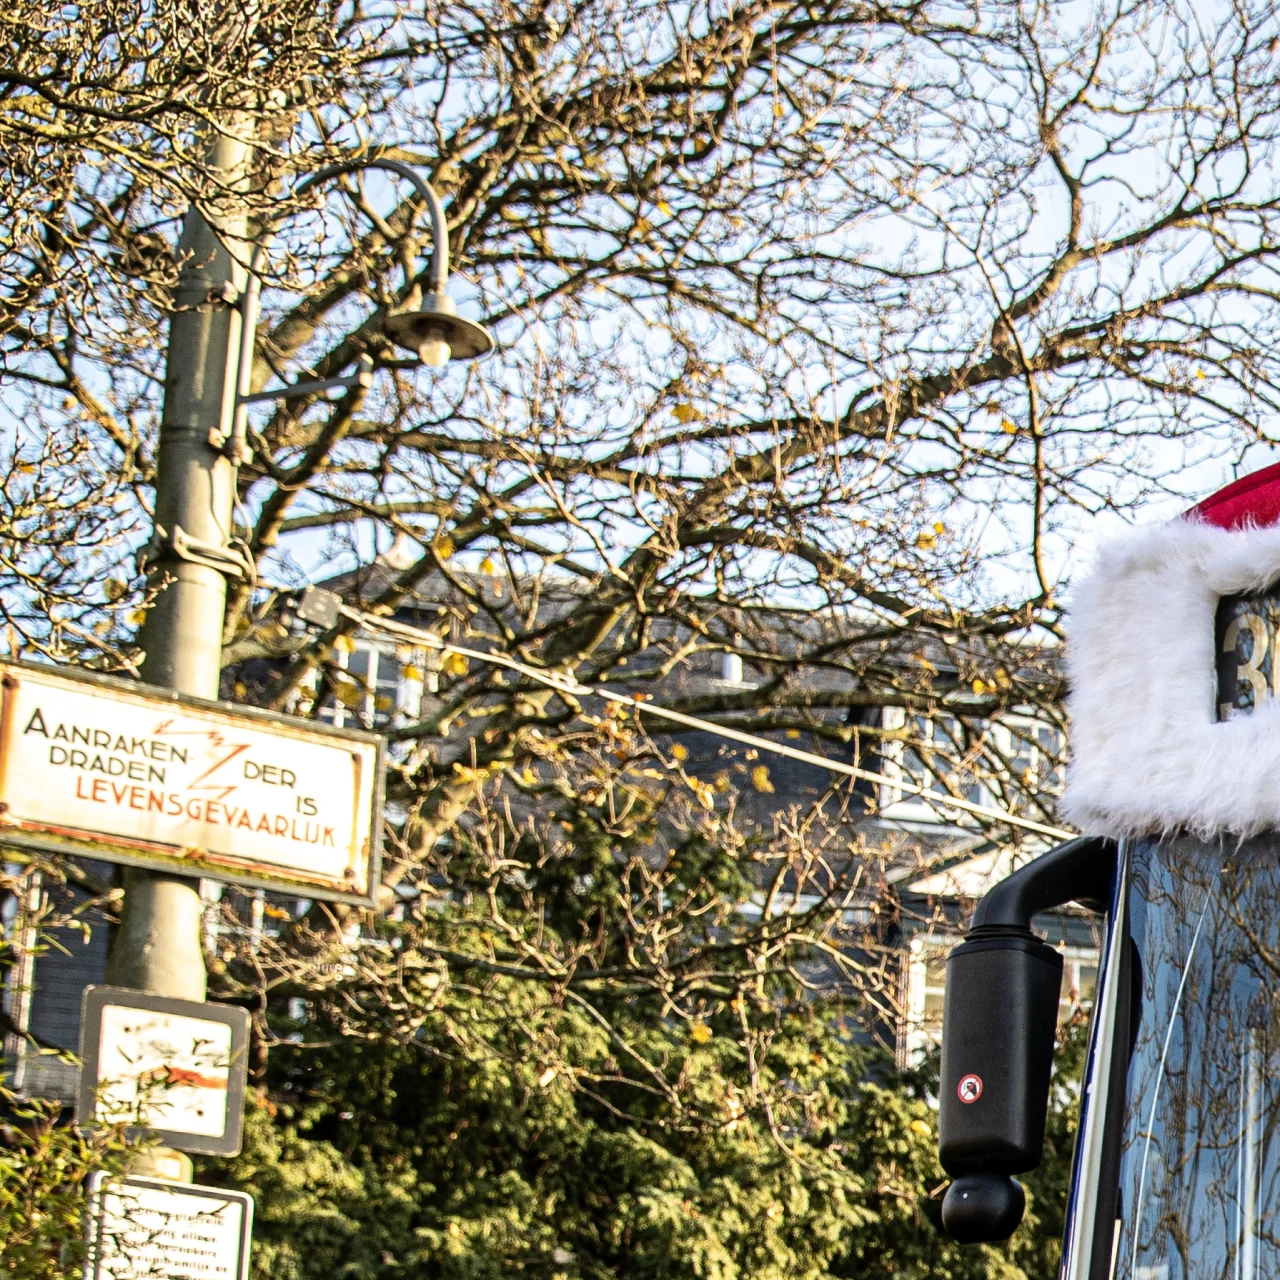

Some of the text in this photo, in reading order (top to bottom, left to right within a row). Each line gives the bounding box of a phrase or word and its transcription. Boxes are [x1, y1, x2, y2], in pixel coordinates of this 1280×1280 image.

[49, 745, 319, 817] DRADEN IS
[242, 759, 297, 789] DER
[75, 774, 338, 849] LEVENSGEVAARLIJK
